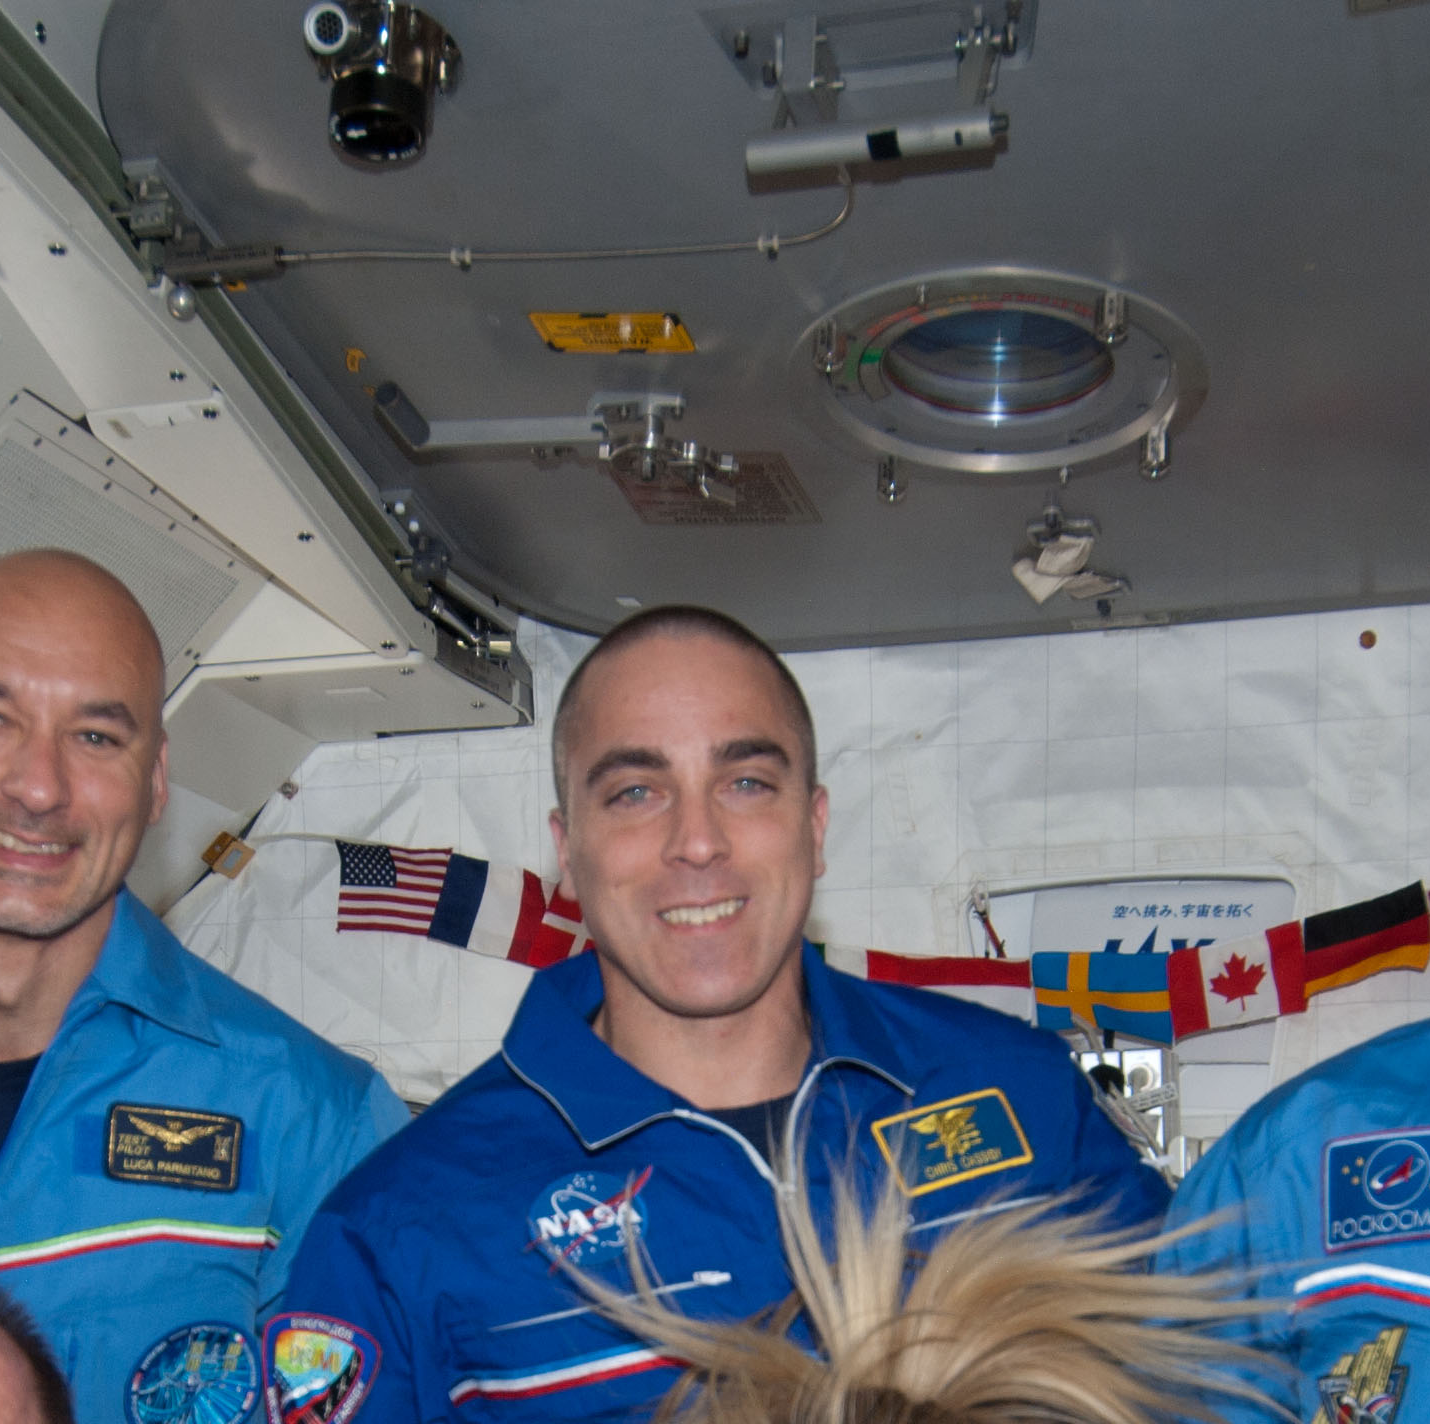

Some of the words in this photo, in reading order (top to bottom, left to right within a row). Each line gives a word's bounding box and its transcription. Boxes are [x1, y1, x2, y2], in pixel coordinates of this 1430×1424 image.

[117, 1143, 151, 1156] PILOT
[123, 1158, 154, 1171] LUCA
[157, 1161, 221, 1180] PARMITANO
[924, 1161, 958, 1180] CHRIS
[960, 1147, 1002, 1168] CASSIDY
[536, 1199, 643, 1243] NASA
